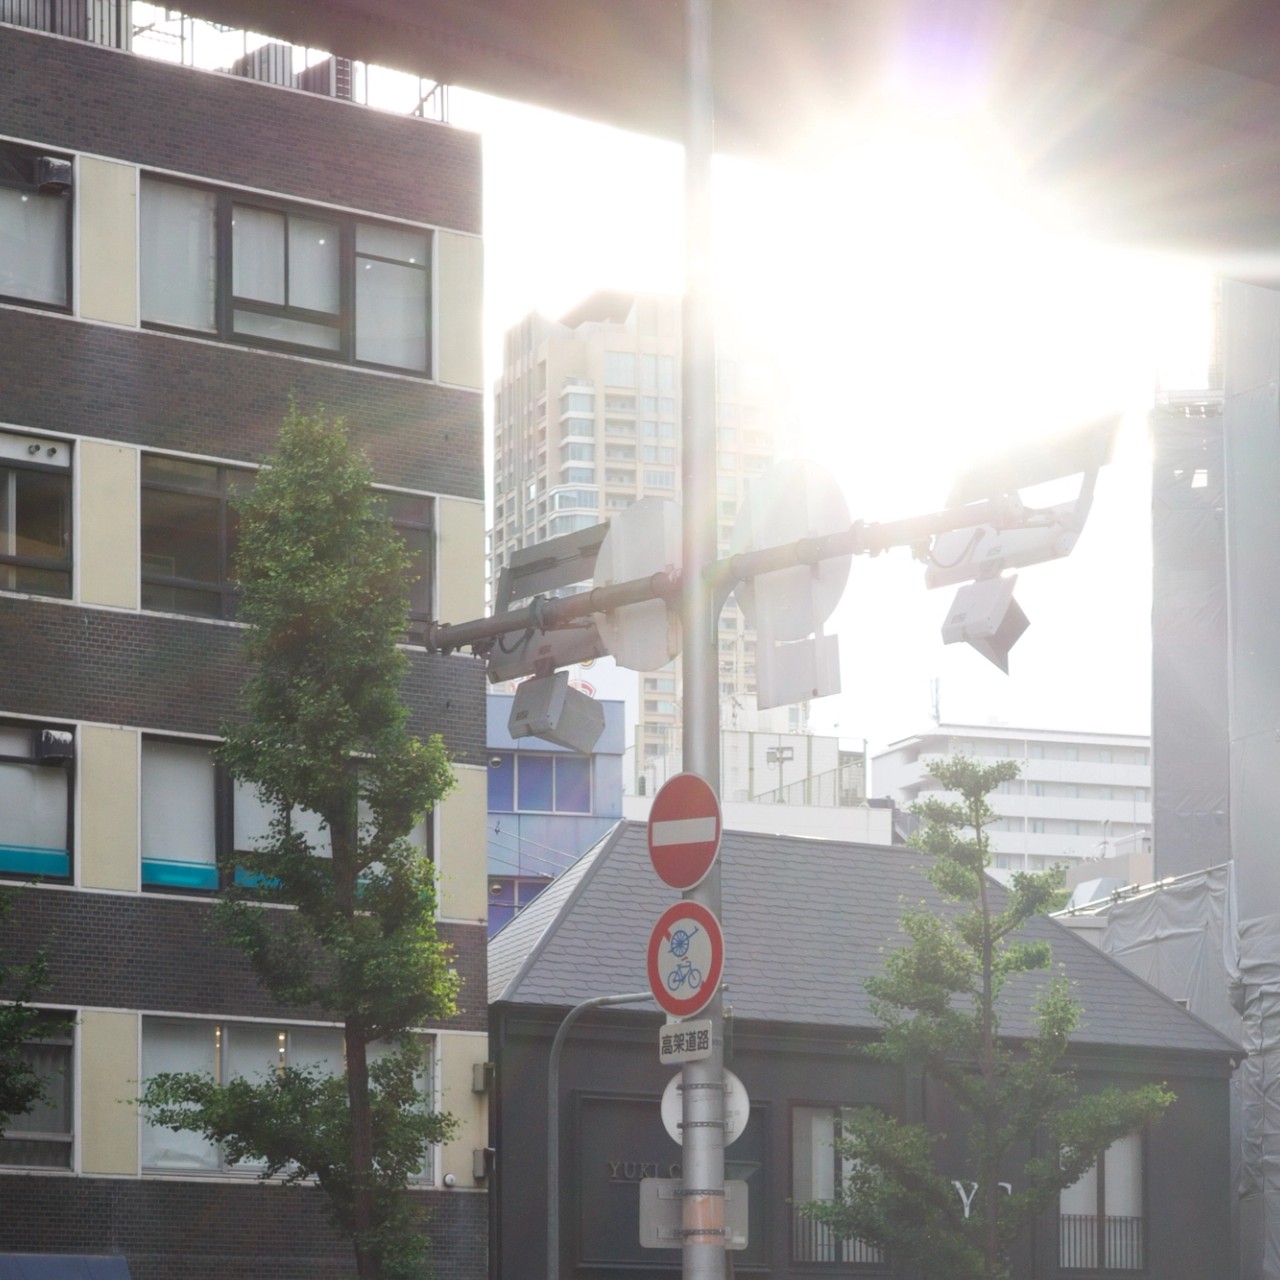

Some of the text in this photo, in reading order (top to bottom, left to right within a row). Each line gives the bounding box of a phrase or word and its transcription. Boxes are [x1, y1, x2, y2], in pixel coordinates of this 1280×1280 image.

[661, 1029, 709, 1056] 高架道路
[609, 1161, 660, 1179] YUKI
